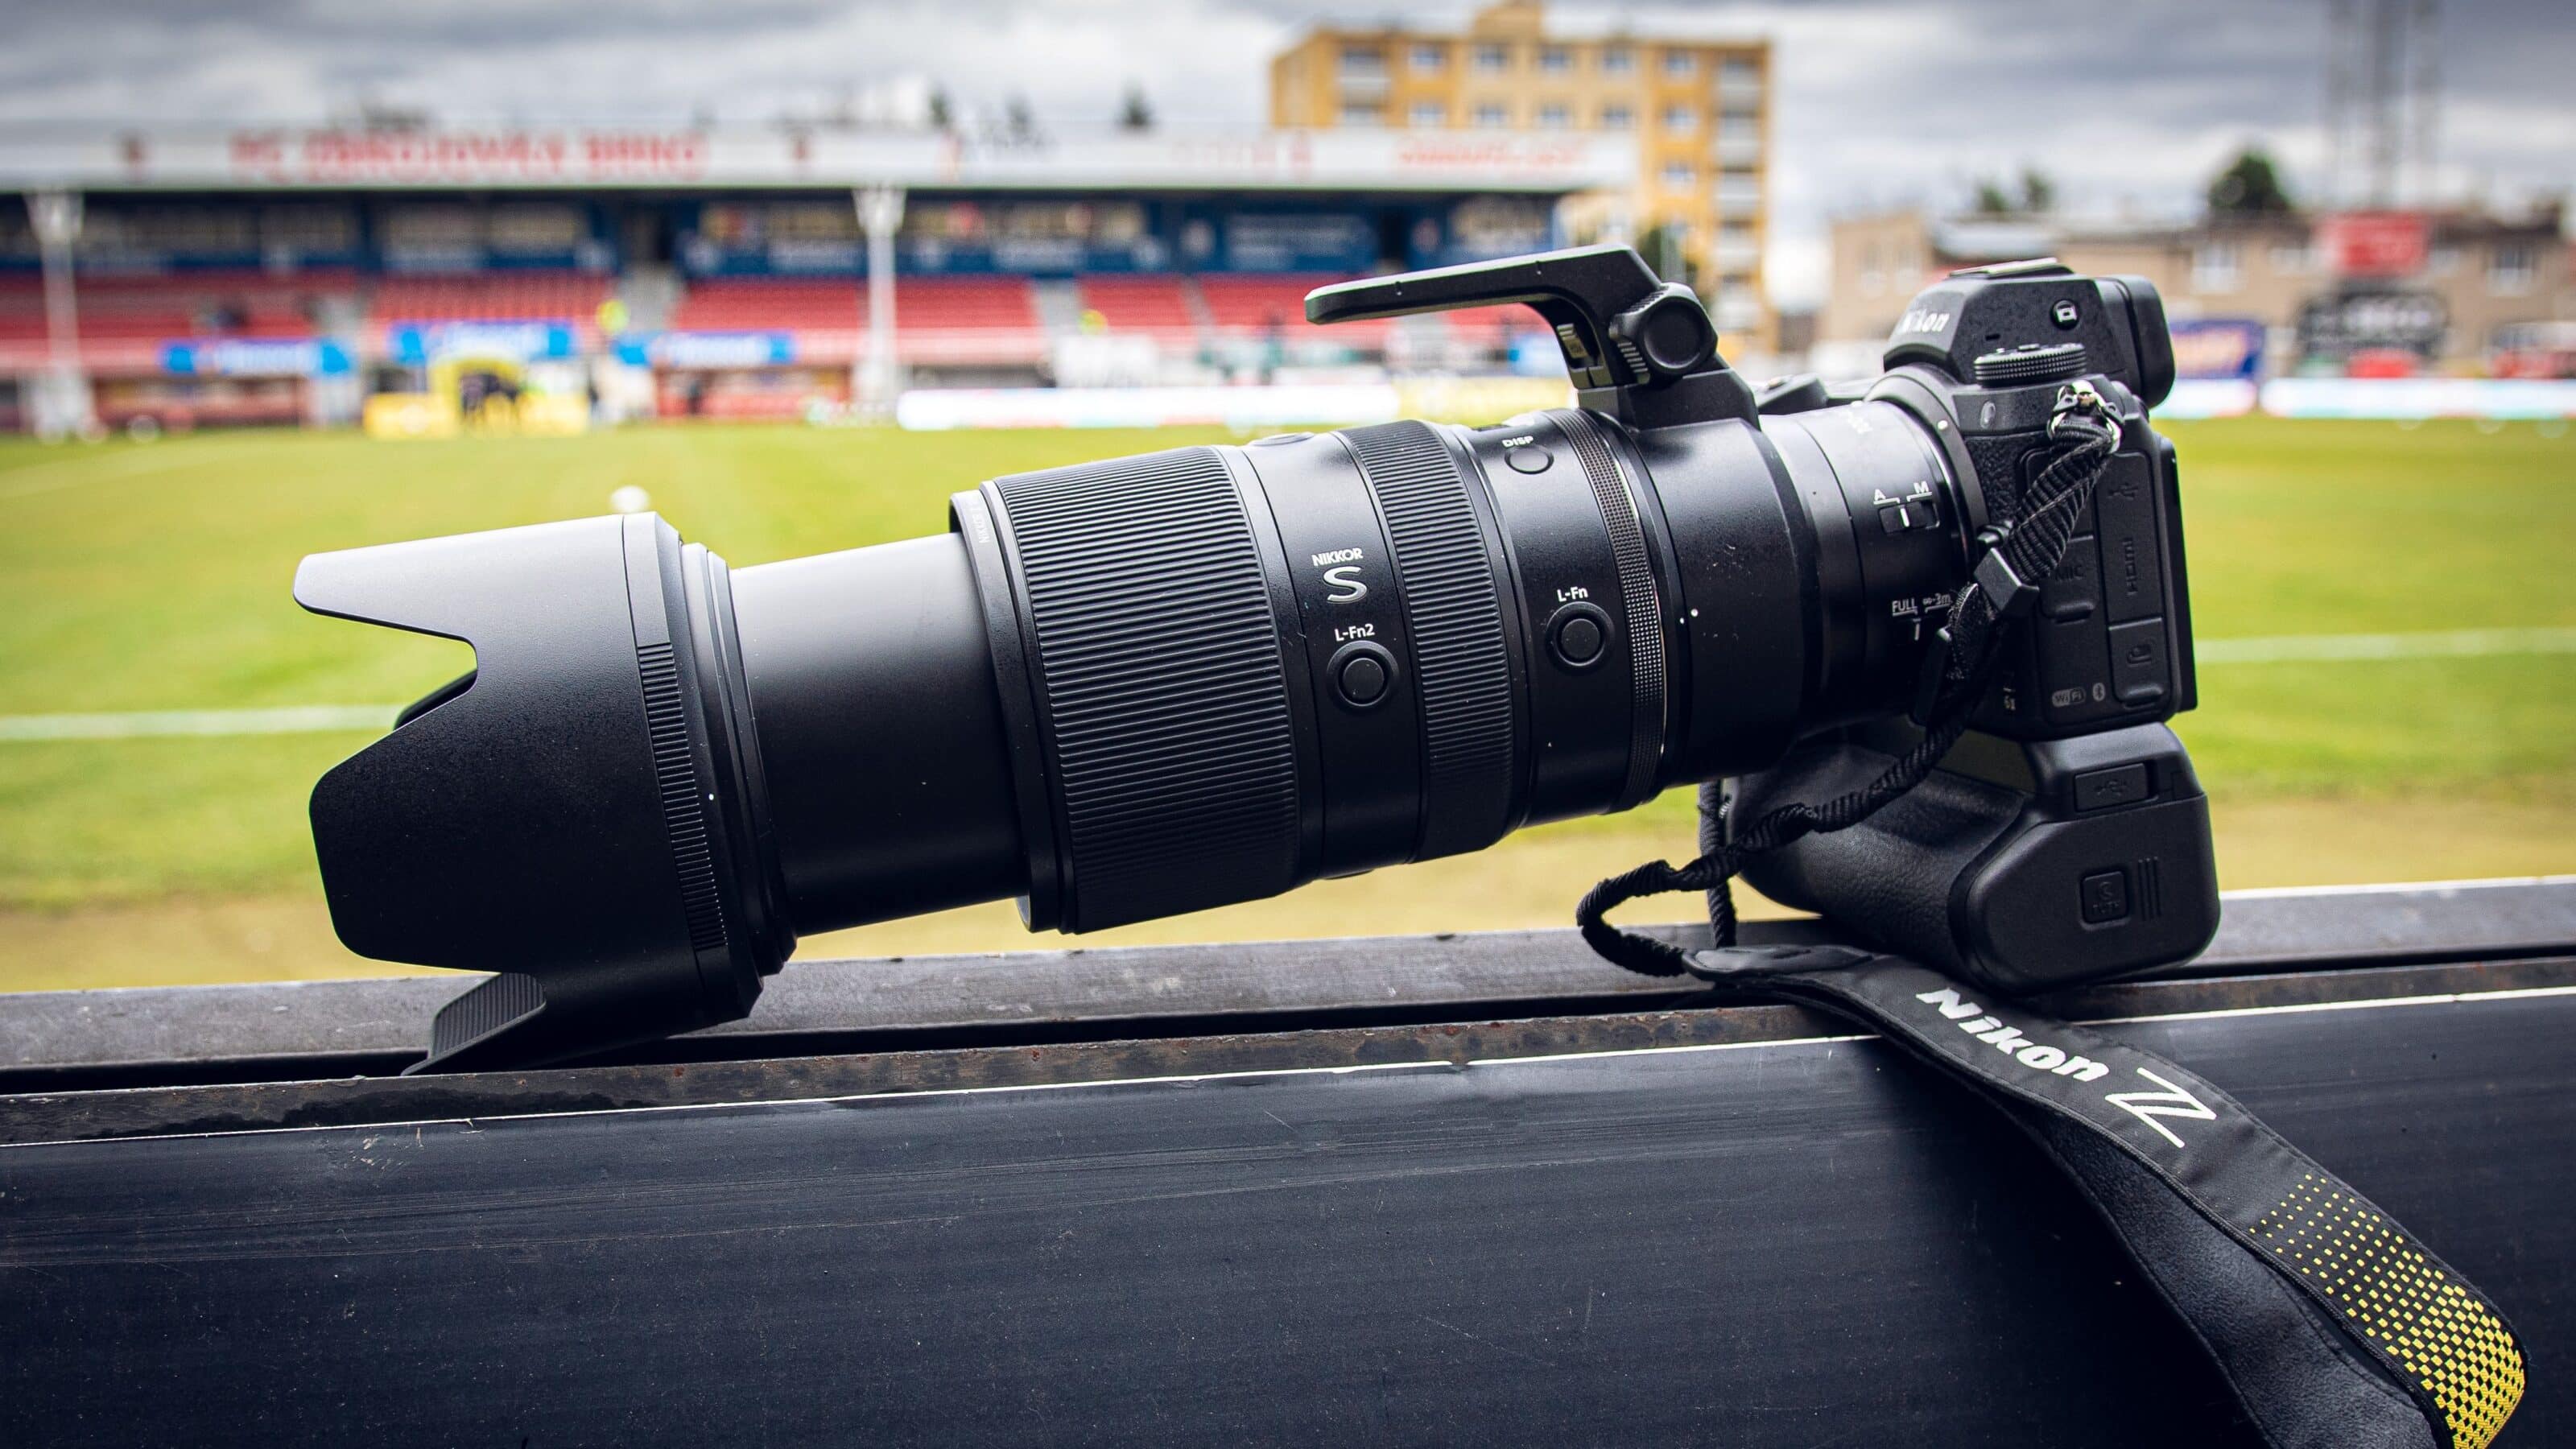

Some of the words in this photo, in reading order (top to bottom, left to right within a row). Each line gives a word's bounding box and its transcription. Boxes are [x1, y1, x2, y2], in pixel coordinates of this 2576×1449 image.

[1501, 436, 1534, 448] DISP
[1874, 489, 1886, 501] A
[1913, 481, 1930, 493] M
[1311, 547, 1364, 567] NIKKOR
[1323, 566, 1368, 604] S
[1556, 586, 1588, 602] L-Fn
[1892, 597, 1918, 612] FULL
[1334, 623, 1375, 642] L-Fn2
[1915, 987, 2110, 1082] Nikon
[2104, 1067, 2216, 1149] Z
